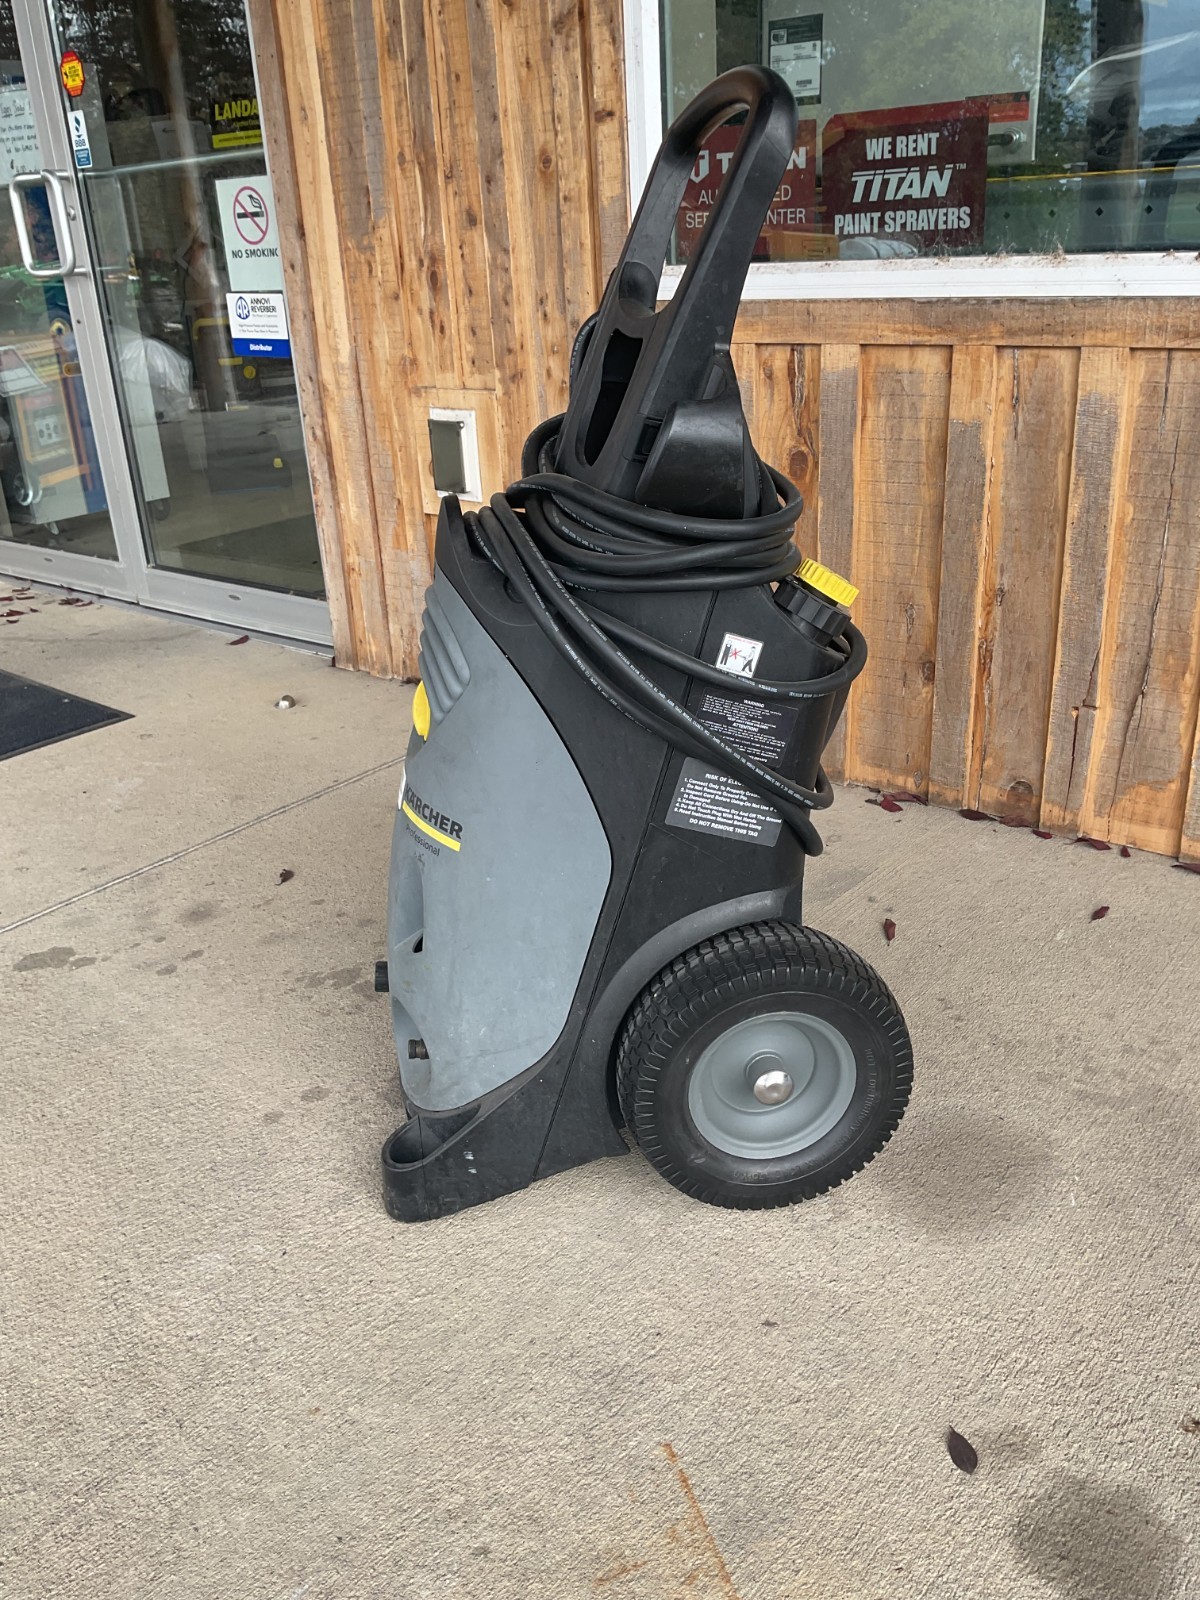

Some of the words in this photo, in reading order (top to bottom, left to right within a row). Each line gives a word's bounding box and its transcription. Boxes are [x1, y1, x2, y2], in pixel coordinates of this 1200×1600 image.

[214, 98, 259, 121] LANDA
[865, 137, 892, 161] WE
[896, 132, 940, 158] RENT
[851, 163, 954, 204] TITAN
[834, 211, 881, 236] PAINT
[884, 206, 971, 233] SPRAYERS
[231, 249, 243, 259] NO
[250, 298, 271, 306] ANNOVI
[249, 343, 273, 352] Distributor
[743, 699, 765, 708] WARNING
[698, 819, 710, 827] NOT
[711, 822, 733, 832] REMOVE
[734, 827, 746, 835] THIS
[747, 830, 758, 838] TAG
[405, 823, 441, 857] Professional
